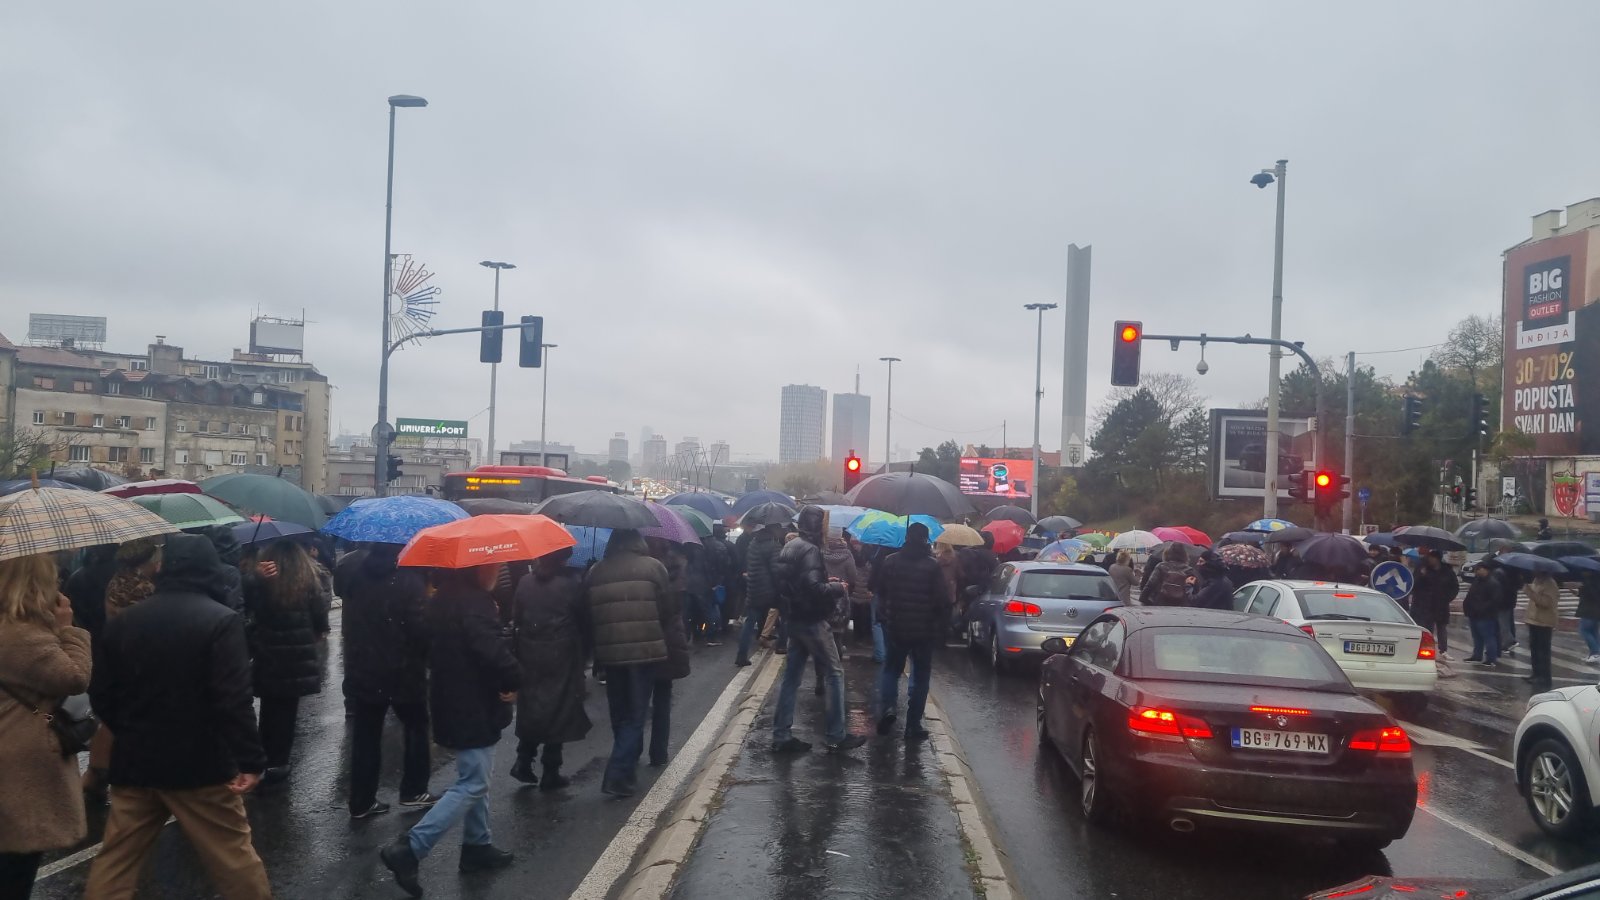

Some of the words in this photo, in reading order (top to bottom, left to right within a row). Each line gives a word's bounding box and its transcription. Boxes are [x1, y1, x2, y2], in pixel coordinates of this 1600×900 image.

[1530, 268, 1562, 294] BIG
[1530, 291, 1562, 304] FASHION
[1531, 304, 1560, 317] OUTLET
[1516, 352, 1575, 385] 30-70%
[1515, 384, 1574, 412] POPUSTA
[400, 423, 464, 434] UNIVEREXPORT
[1515, 414, 1544, 435] SVAKI
[1550, 412, 1575, 433] DAN
[1243, 731, 1261, 746] BG
